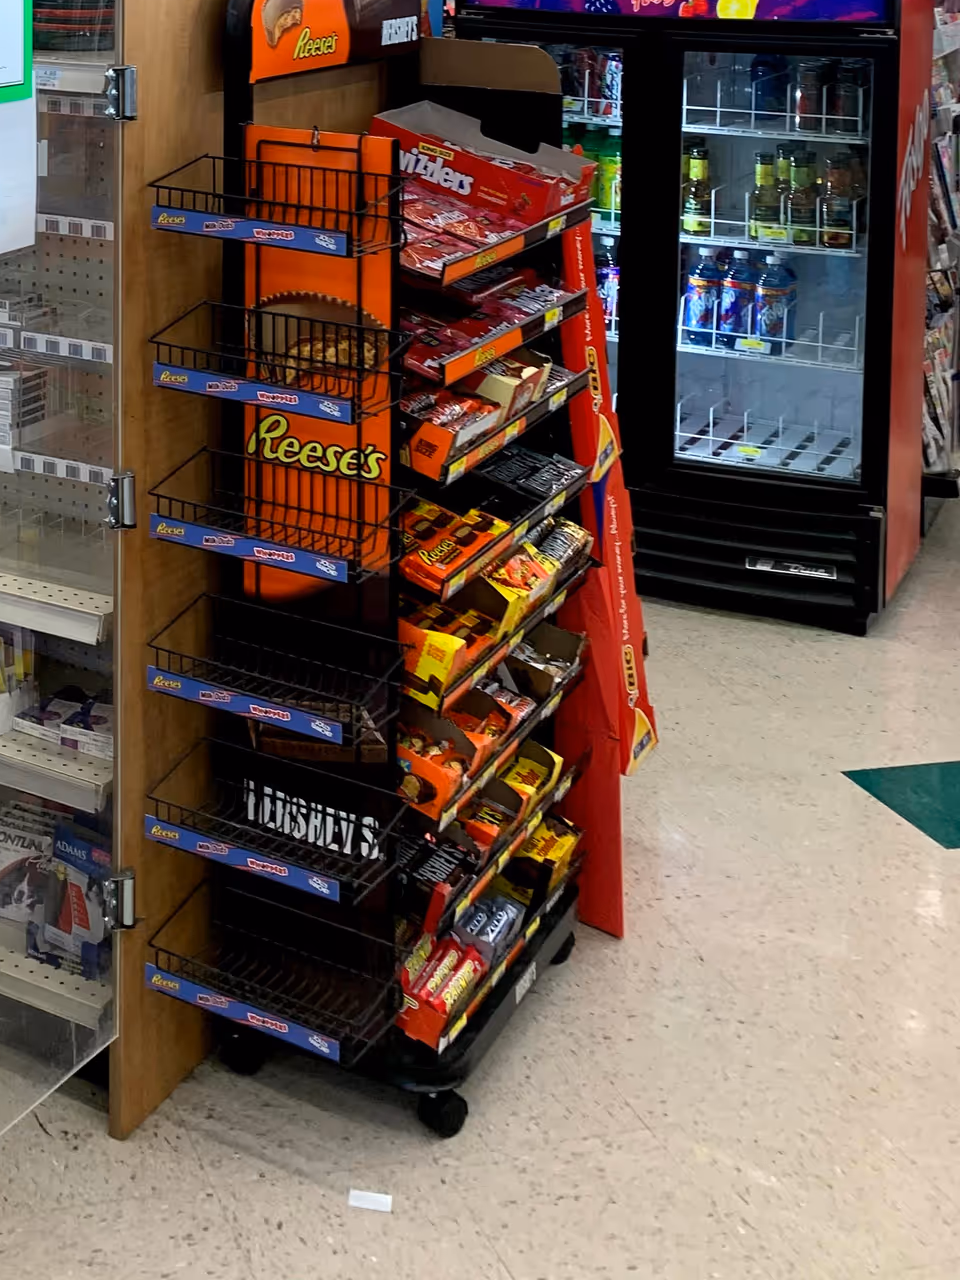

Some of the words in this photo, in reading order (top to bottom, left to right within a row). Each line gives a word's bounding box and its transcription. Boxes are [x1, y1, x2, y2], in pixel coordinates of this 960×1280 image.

[293, 27, 339, 59] Reese's
[399, 147, 474, 196] wizzlers
[247, 413, 387, 480] Reese's
[414, 446, 435, 460] SIZE
[419, 438, 439, 452] KING
[56, 841, 86, 860] ADAMS
